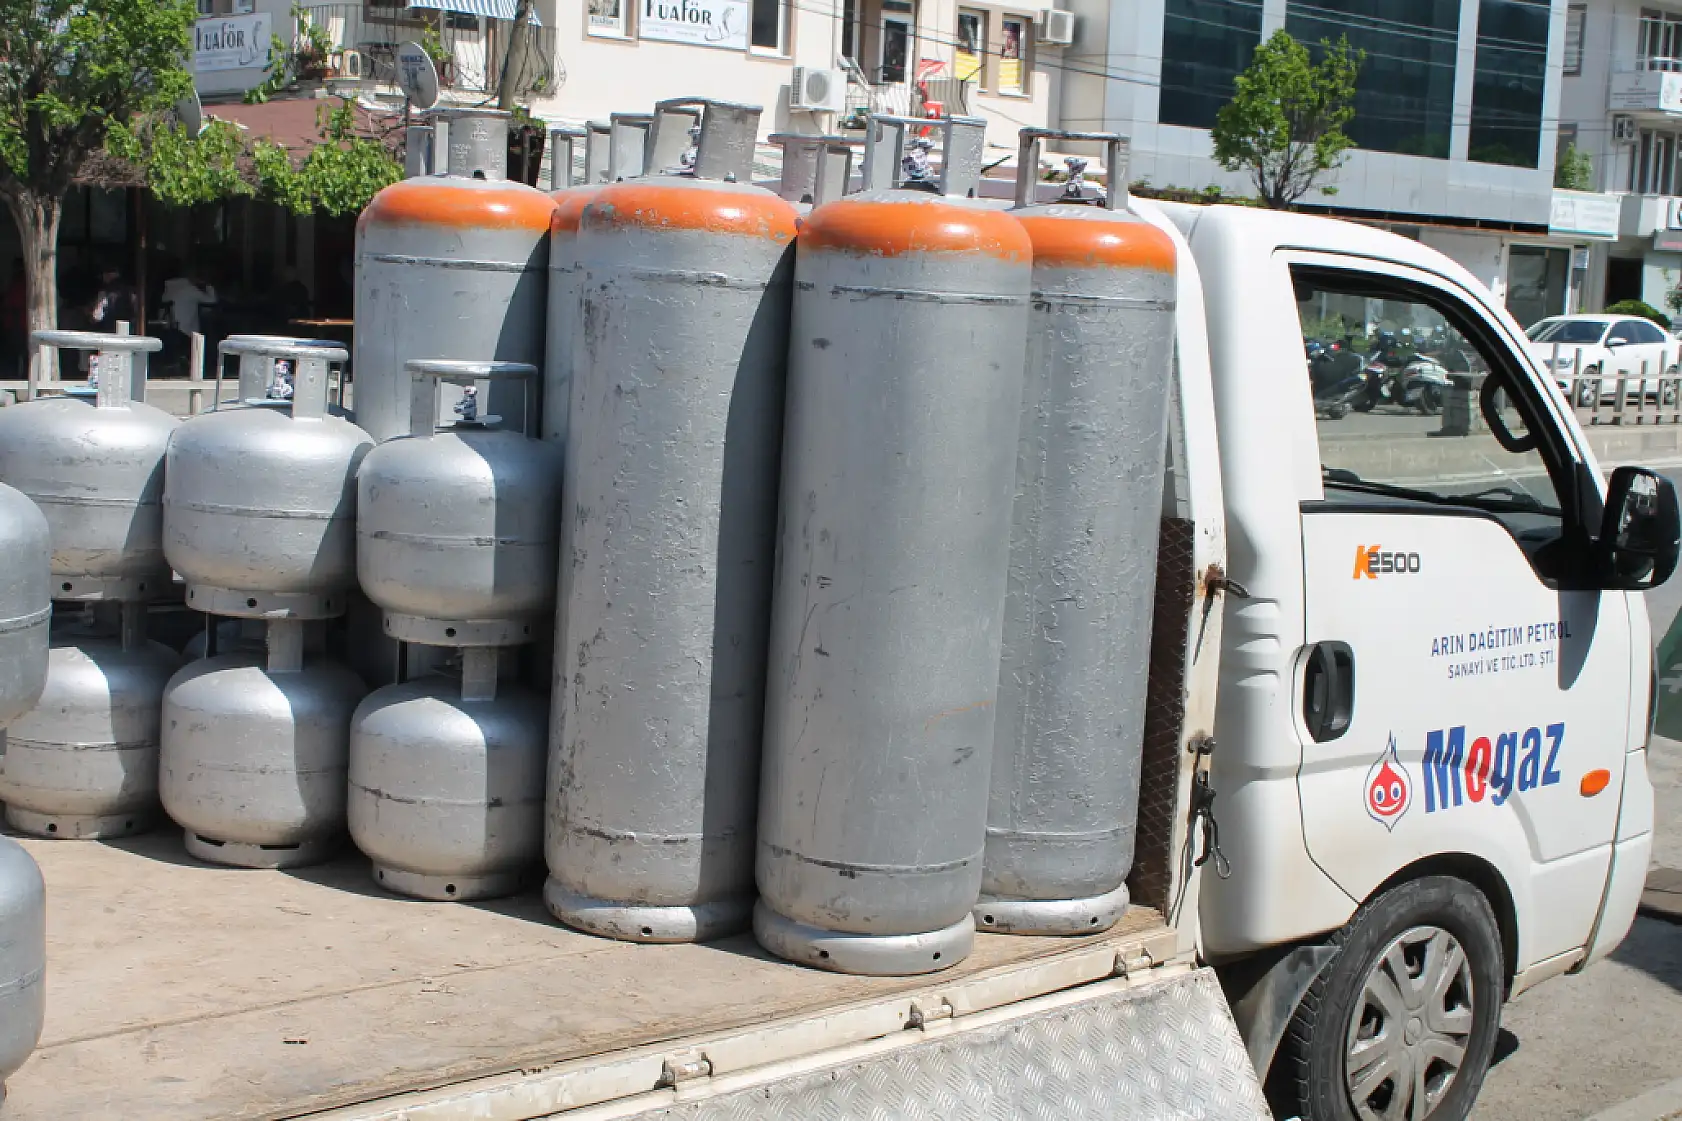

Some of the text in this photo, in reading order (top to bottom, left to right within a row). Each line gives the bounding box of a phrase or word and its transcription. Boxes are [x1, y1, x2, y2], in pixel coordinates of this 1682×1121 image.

[1353, 545, 1420, 579] K2500
[1431, 620, 1572, 657] ARIN DAĞITIM PETROL
[1448, 656, 1483, 679] SANAYİ
[1486, 657, 1499, 673] VE
[1422, 722, 1565, 814] Mogaz
